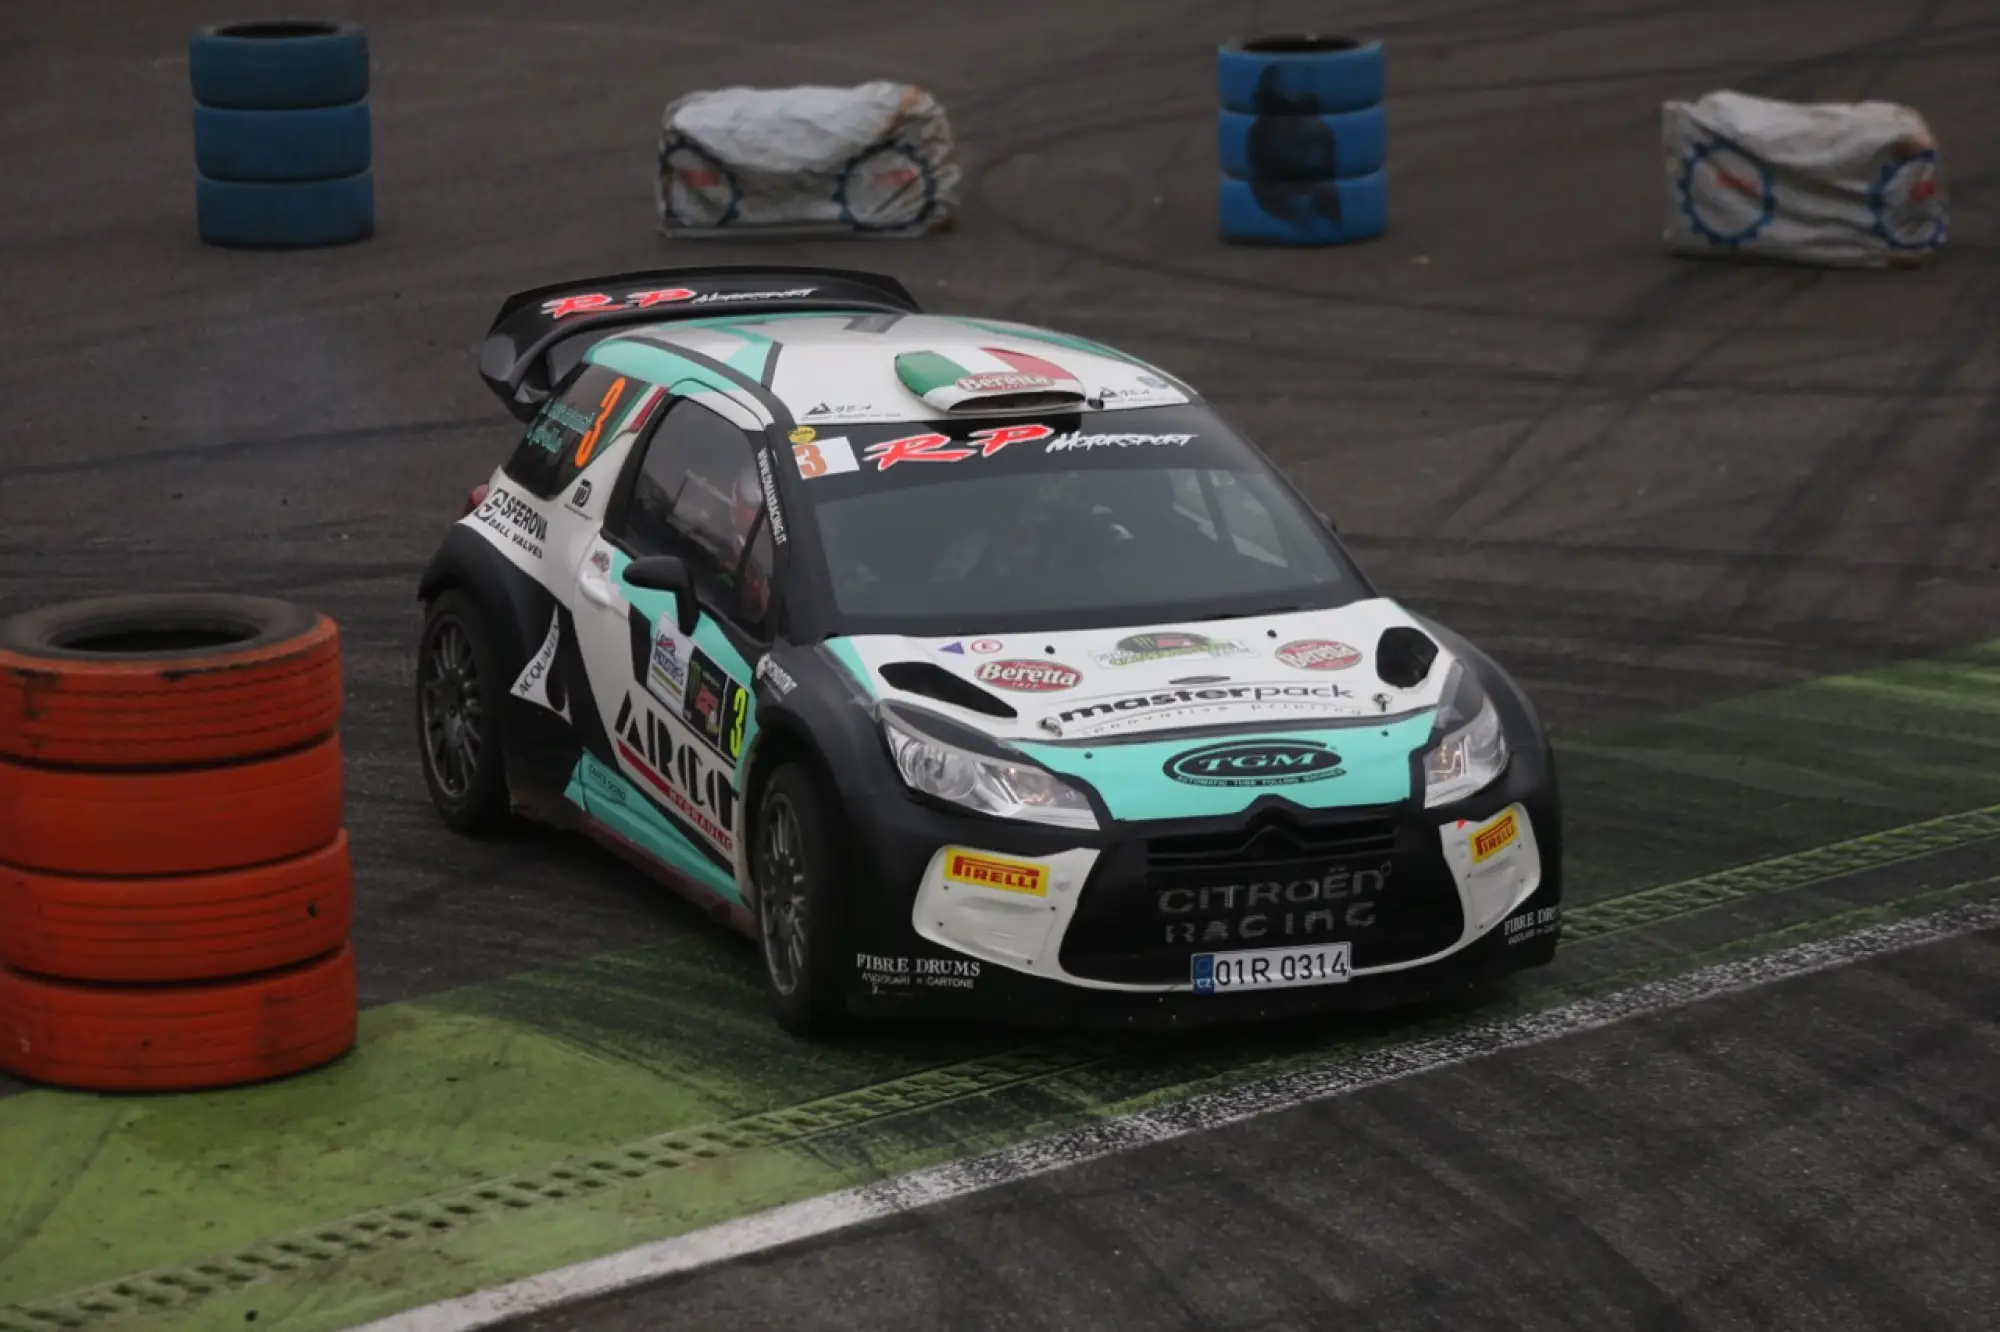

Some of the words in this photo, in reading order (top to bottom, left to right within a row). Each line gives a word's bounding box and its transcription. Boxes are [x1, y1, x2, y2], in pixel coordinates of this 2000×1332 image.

[574, 377, 626, 468] 3
[792, 444, 827, 477] 3
[501, 496, 548, 544] SFEROVA
[512, 533, 543, 559] VALVES
[981, 663, 1077, 687] Beretta
[1059, 684, 1355, 722] masterpack
[729, 688, 748, 758] 3
[1199, 751, 1321, 772] TGM
[1475, 815, 1514, 856] PIRELLI
[952, 855, 1040, 890] PIRELLI
[1165, 900, 1376, 943] RACING
[857, 953, 909, 973] FIBRE
[916, 958, 980, 977] DRUMS
[1215, 959, 1272, 986] 01R
[1281, 951, 1347, 981] 0314
